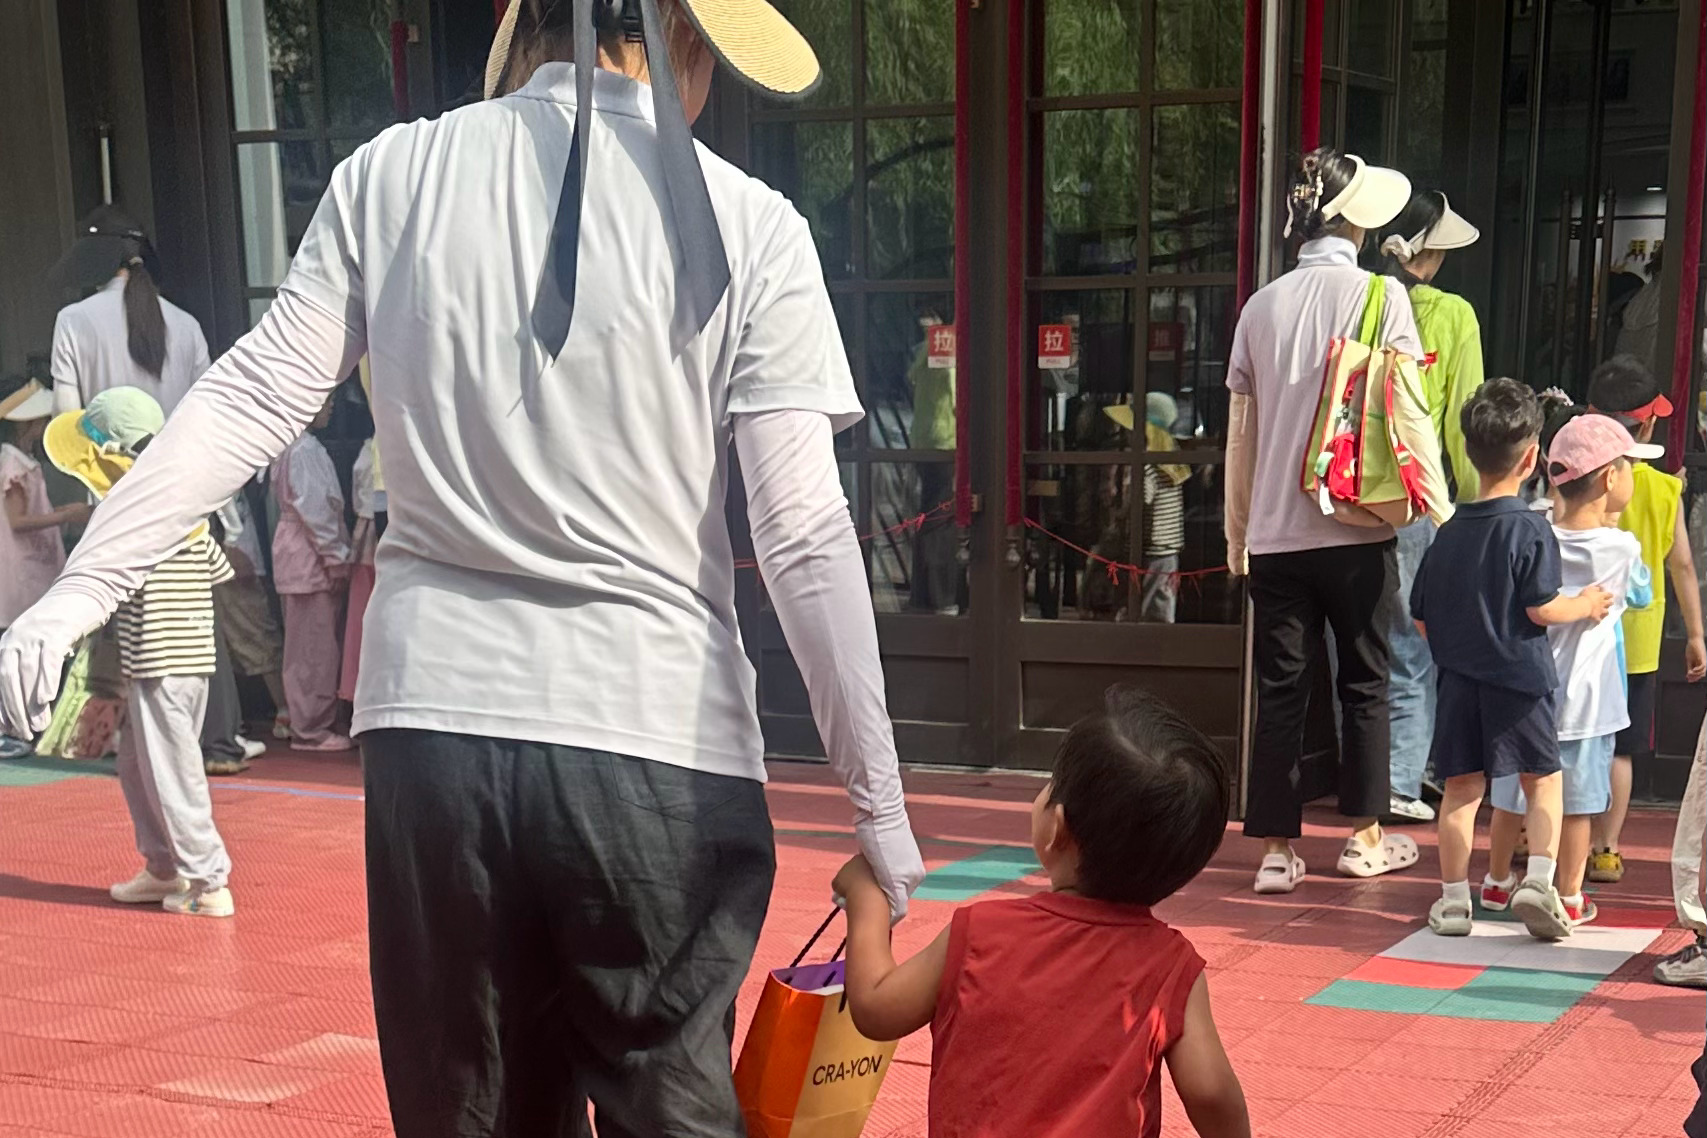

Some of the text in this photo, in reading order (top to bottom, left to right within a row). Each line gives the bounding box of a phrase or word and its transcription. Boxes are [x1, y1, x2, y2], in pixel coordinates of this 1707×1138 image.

[933, 330, 953, 352] 拉
[1044, 330, 1064, 352] 拉
[812, 1054, 883, 1086] CRA-YON
